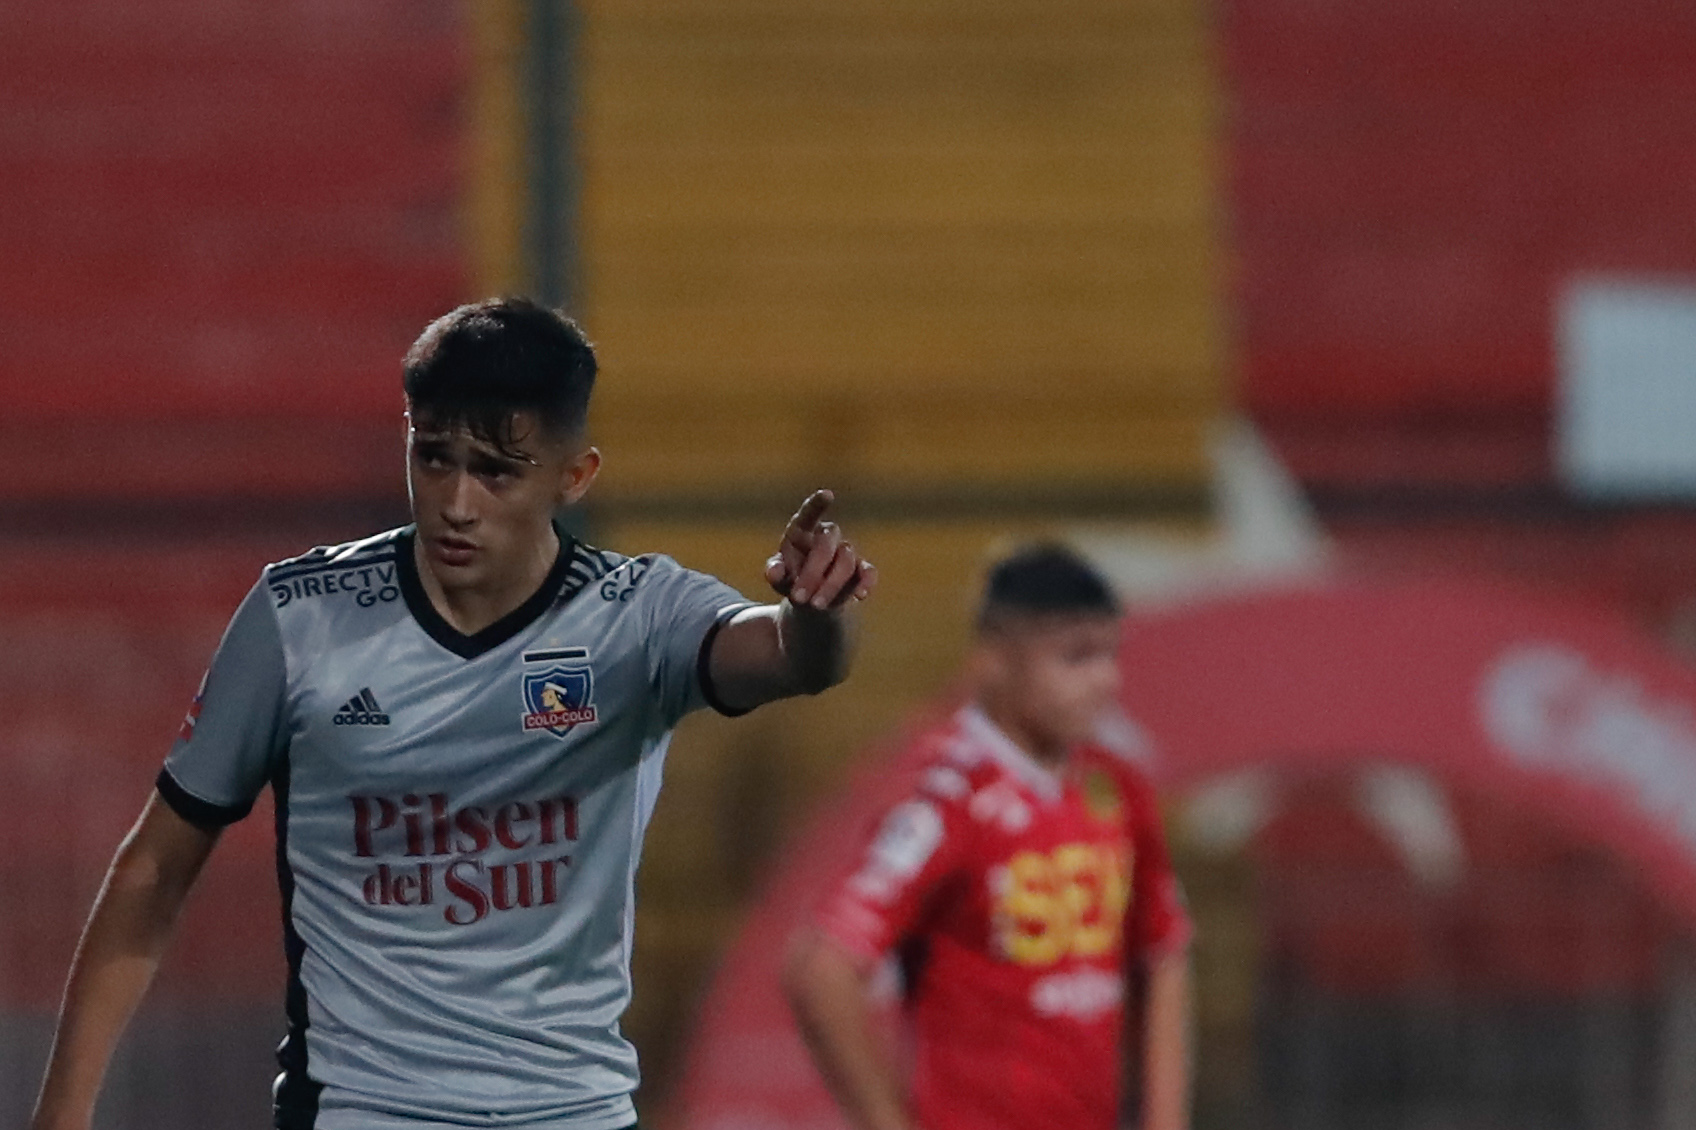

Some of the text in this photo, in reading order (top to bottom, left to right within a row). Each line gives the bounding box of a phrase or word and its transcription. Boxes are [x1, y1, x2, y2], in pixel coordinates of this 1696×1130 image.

[270, 564, 394, 608] DIRECTV
[356, 585, 399, 607] GO
[333, 710, 390, 726] adidas
[526, 708, 593, 727] COLO-COLO
[346, 792, 580, 858] Pilsen
[362, 856, 572, 926] del Sur
